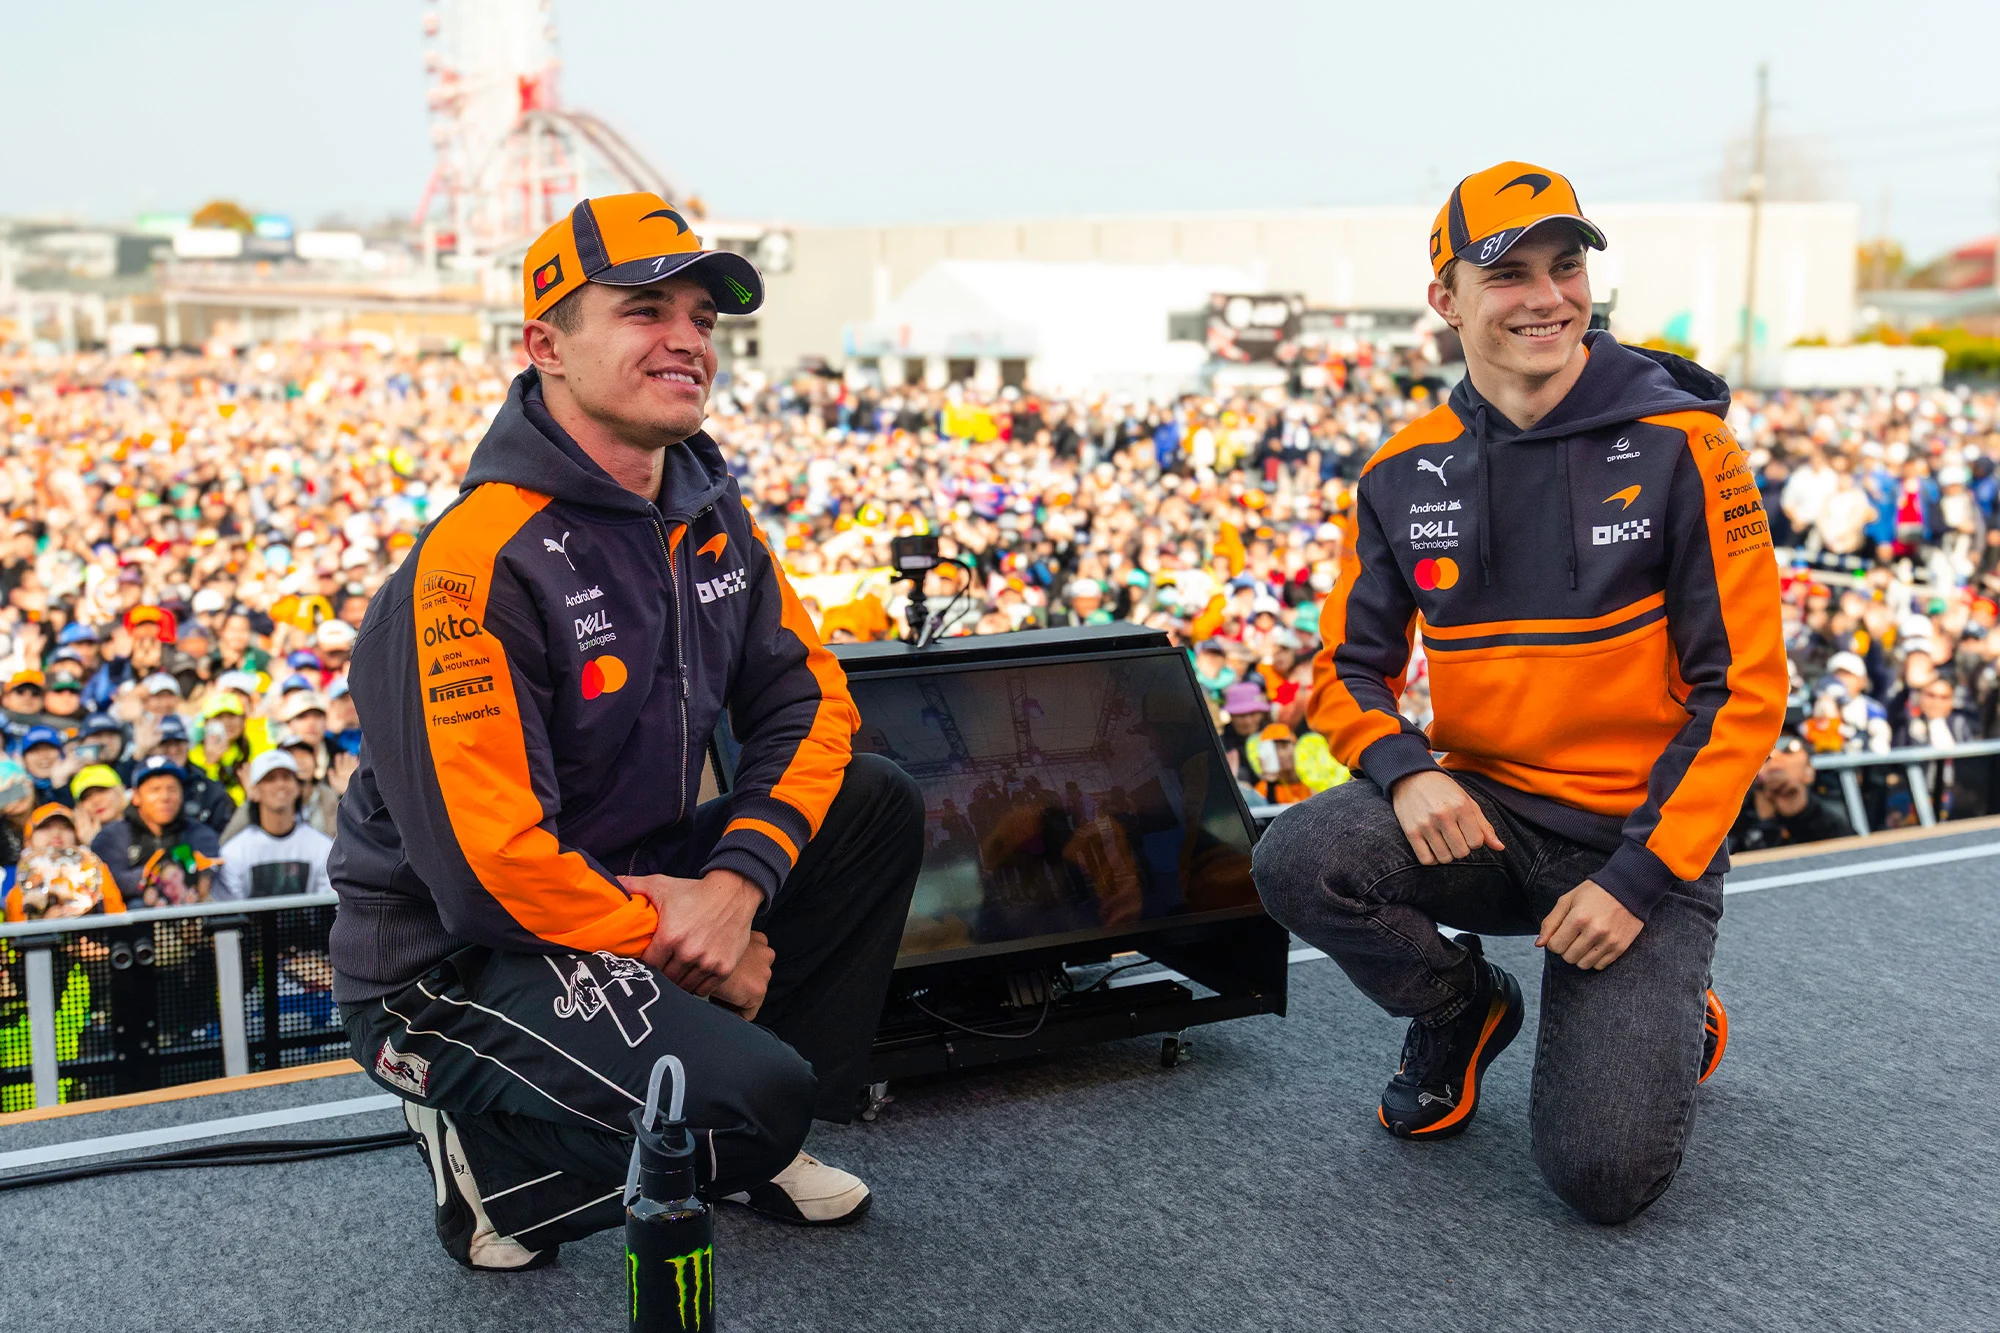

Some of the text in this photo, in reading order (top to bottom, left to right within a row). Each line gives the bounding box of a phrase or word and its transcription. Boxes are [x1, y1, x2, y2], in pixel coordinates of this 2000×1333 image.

[1480, 231, 1506, 259] 81
[651, 256, 666, 273] 1
[1616, 451, 1641, 461] WORLD
[1409, 500, 1447, 514] Android
[1410, 520, 1459, 540] DELL
[1592, 518, 1651, 546] OKX
[1410, 539, 1459, 550] Technologies
[1727, 543, 1760, 558] RICHARD
[422, 575, 468, 595] Hilton
[421, 601, 433, 612] FOR
[434, 595, 448, 607] THE
[423, 614, 483, 647] okta
[574, 609, 613, 640] DELL
[442, 651, 463, 662] IRON
[445, 656, 491, 672] MOUNTAIN
[429, 675, 495, 704] PIRELLI
[432, 704, 501, 727] freshworks
